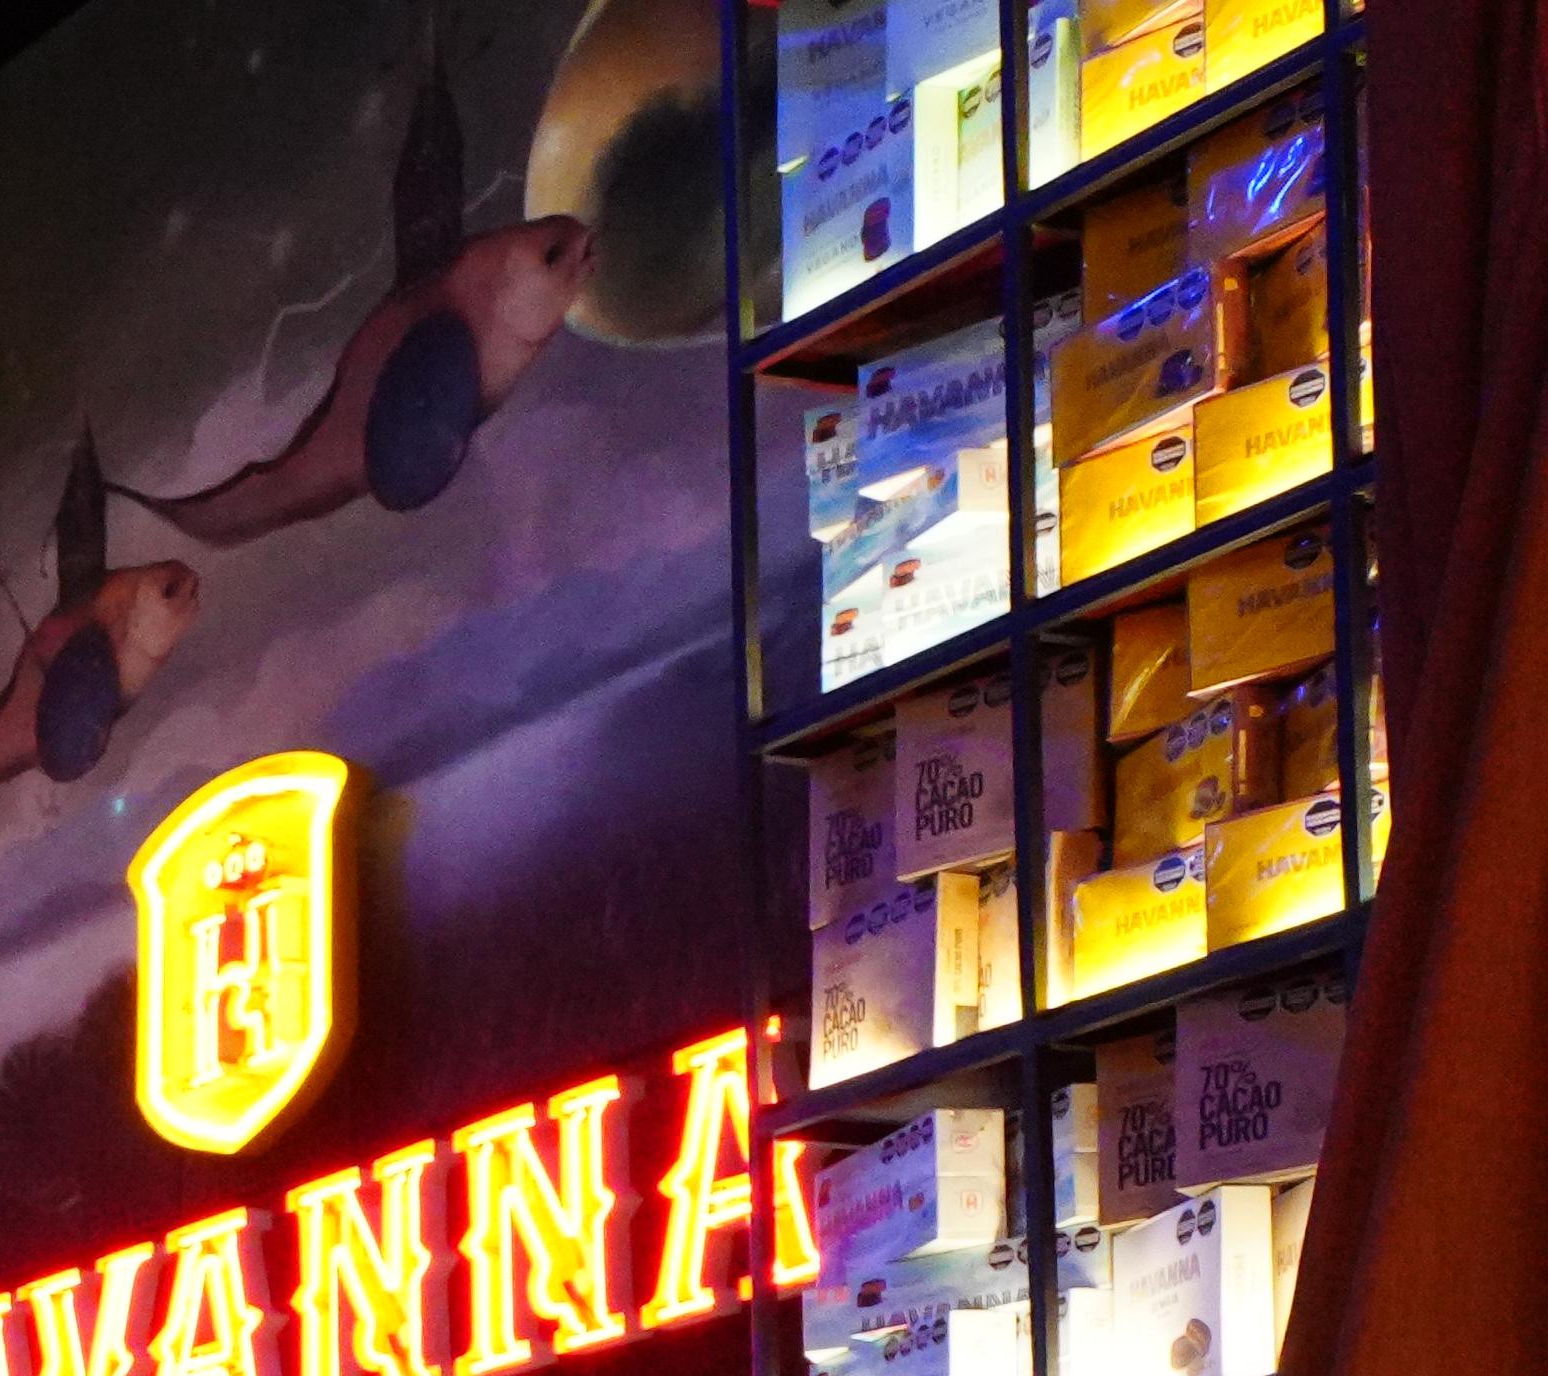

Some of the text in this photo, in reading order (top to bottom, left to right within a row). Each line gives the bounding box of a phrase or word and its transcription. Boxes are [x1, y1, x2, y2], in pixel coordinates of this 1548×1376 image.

[915, 771, 984, 810] CACAO
[916, 803, 974, 841] PURO
[1200, 1060, 1257, 1093] 70%
[1199, 1080, 1282, 1121] CACAO
[1198, 1111, 1270, 1151] PURO
